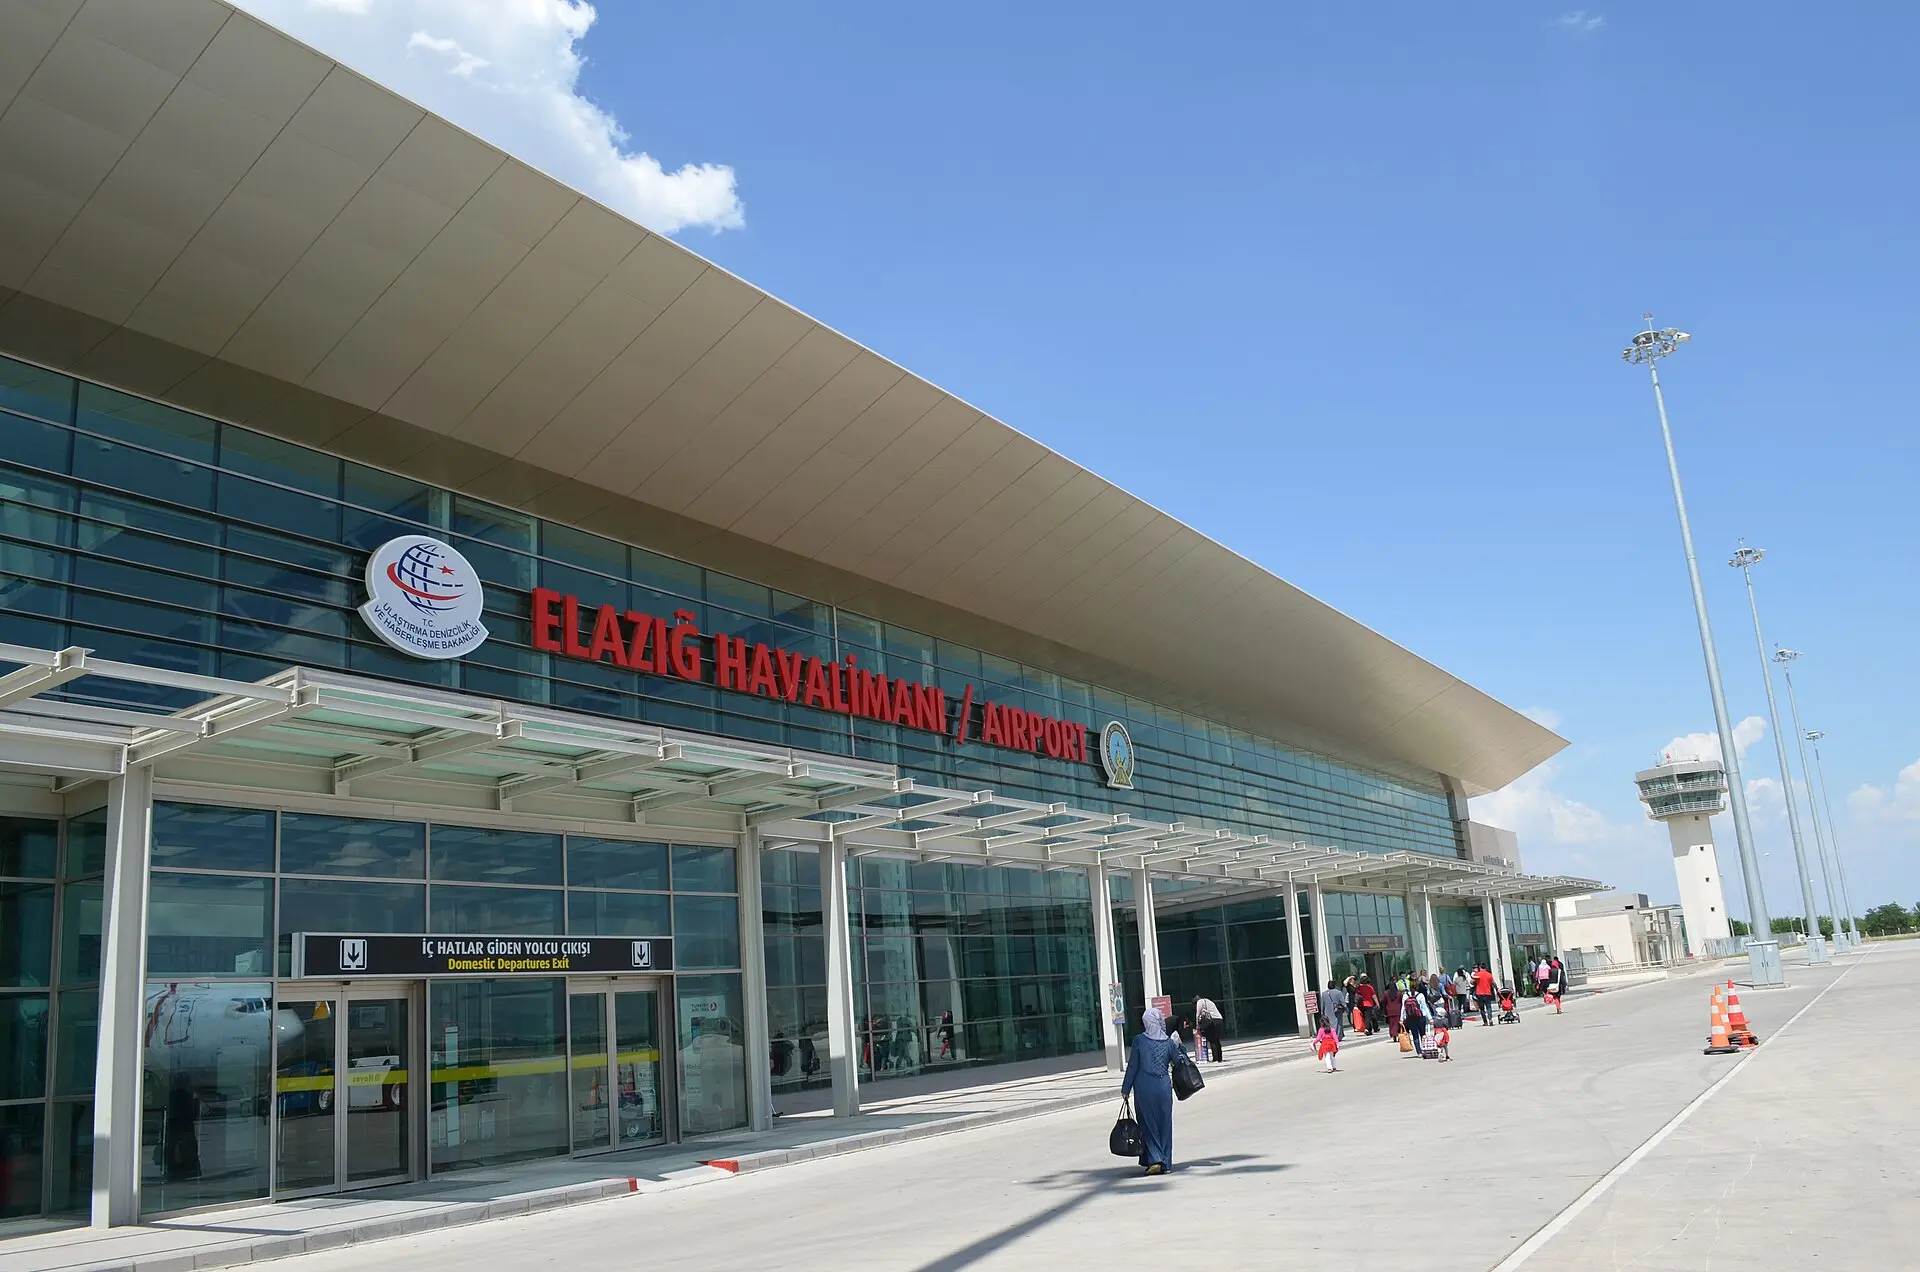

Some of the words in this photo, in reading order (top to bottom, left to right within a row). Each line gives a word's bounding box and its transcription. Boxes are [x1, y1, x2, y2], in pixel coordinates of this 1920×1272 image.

[374, 605, 386, 620] VE
[383, 618, 440, 650] HABERLEŞME
[441, 625, 481, 649] BAKANLIĞI
[383, 603, 428, 638] ULAŞTIRMA
[430, 620, 472, 639] DENİZCİLİK
[422, 618, 436, 628] T.C.
[532, 587, 702, 682] ELAZIĞ
[715, 632, 947, 734] HAVALİMANI
[955, 683, 974, 745] /
[981, 700, 1087, 764] AIRPORT
[422, 937, 434, 958] İÇ
[437, 941, 484, 955] HATLAR
[487, 938, 522, 955] GİDEN
[524, 941, 558, 955] YOLCU
[561, 941, 591, 958] ÇIKIŞI
[448, 957, 495, 970] Domestic
[497, 957, 550, 972] Departures
[552, 956, 570, 969] Exit
